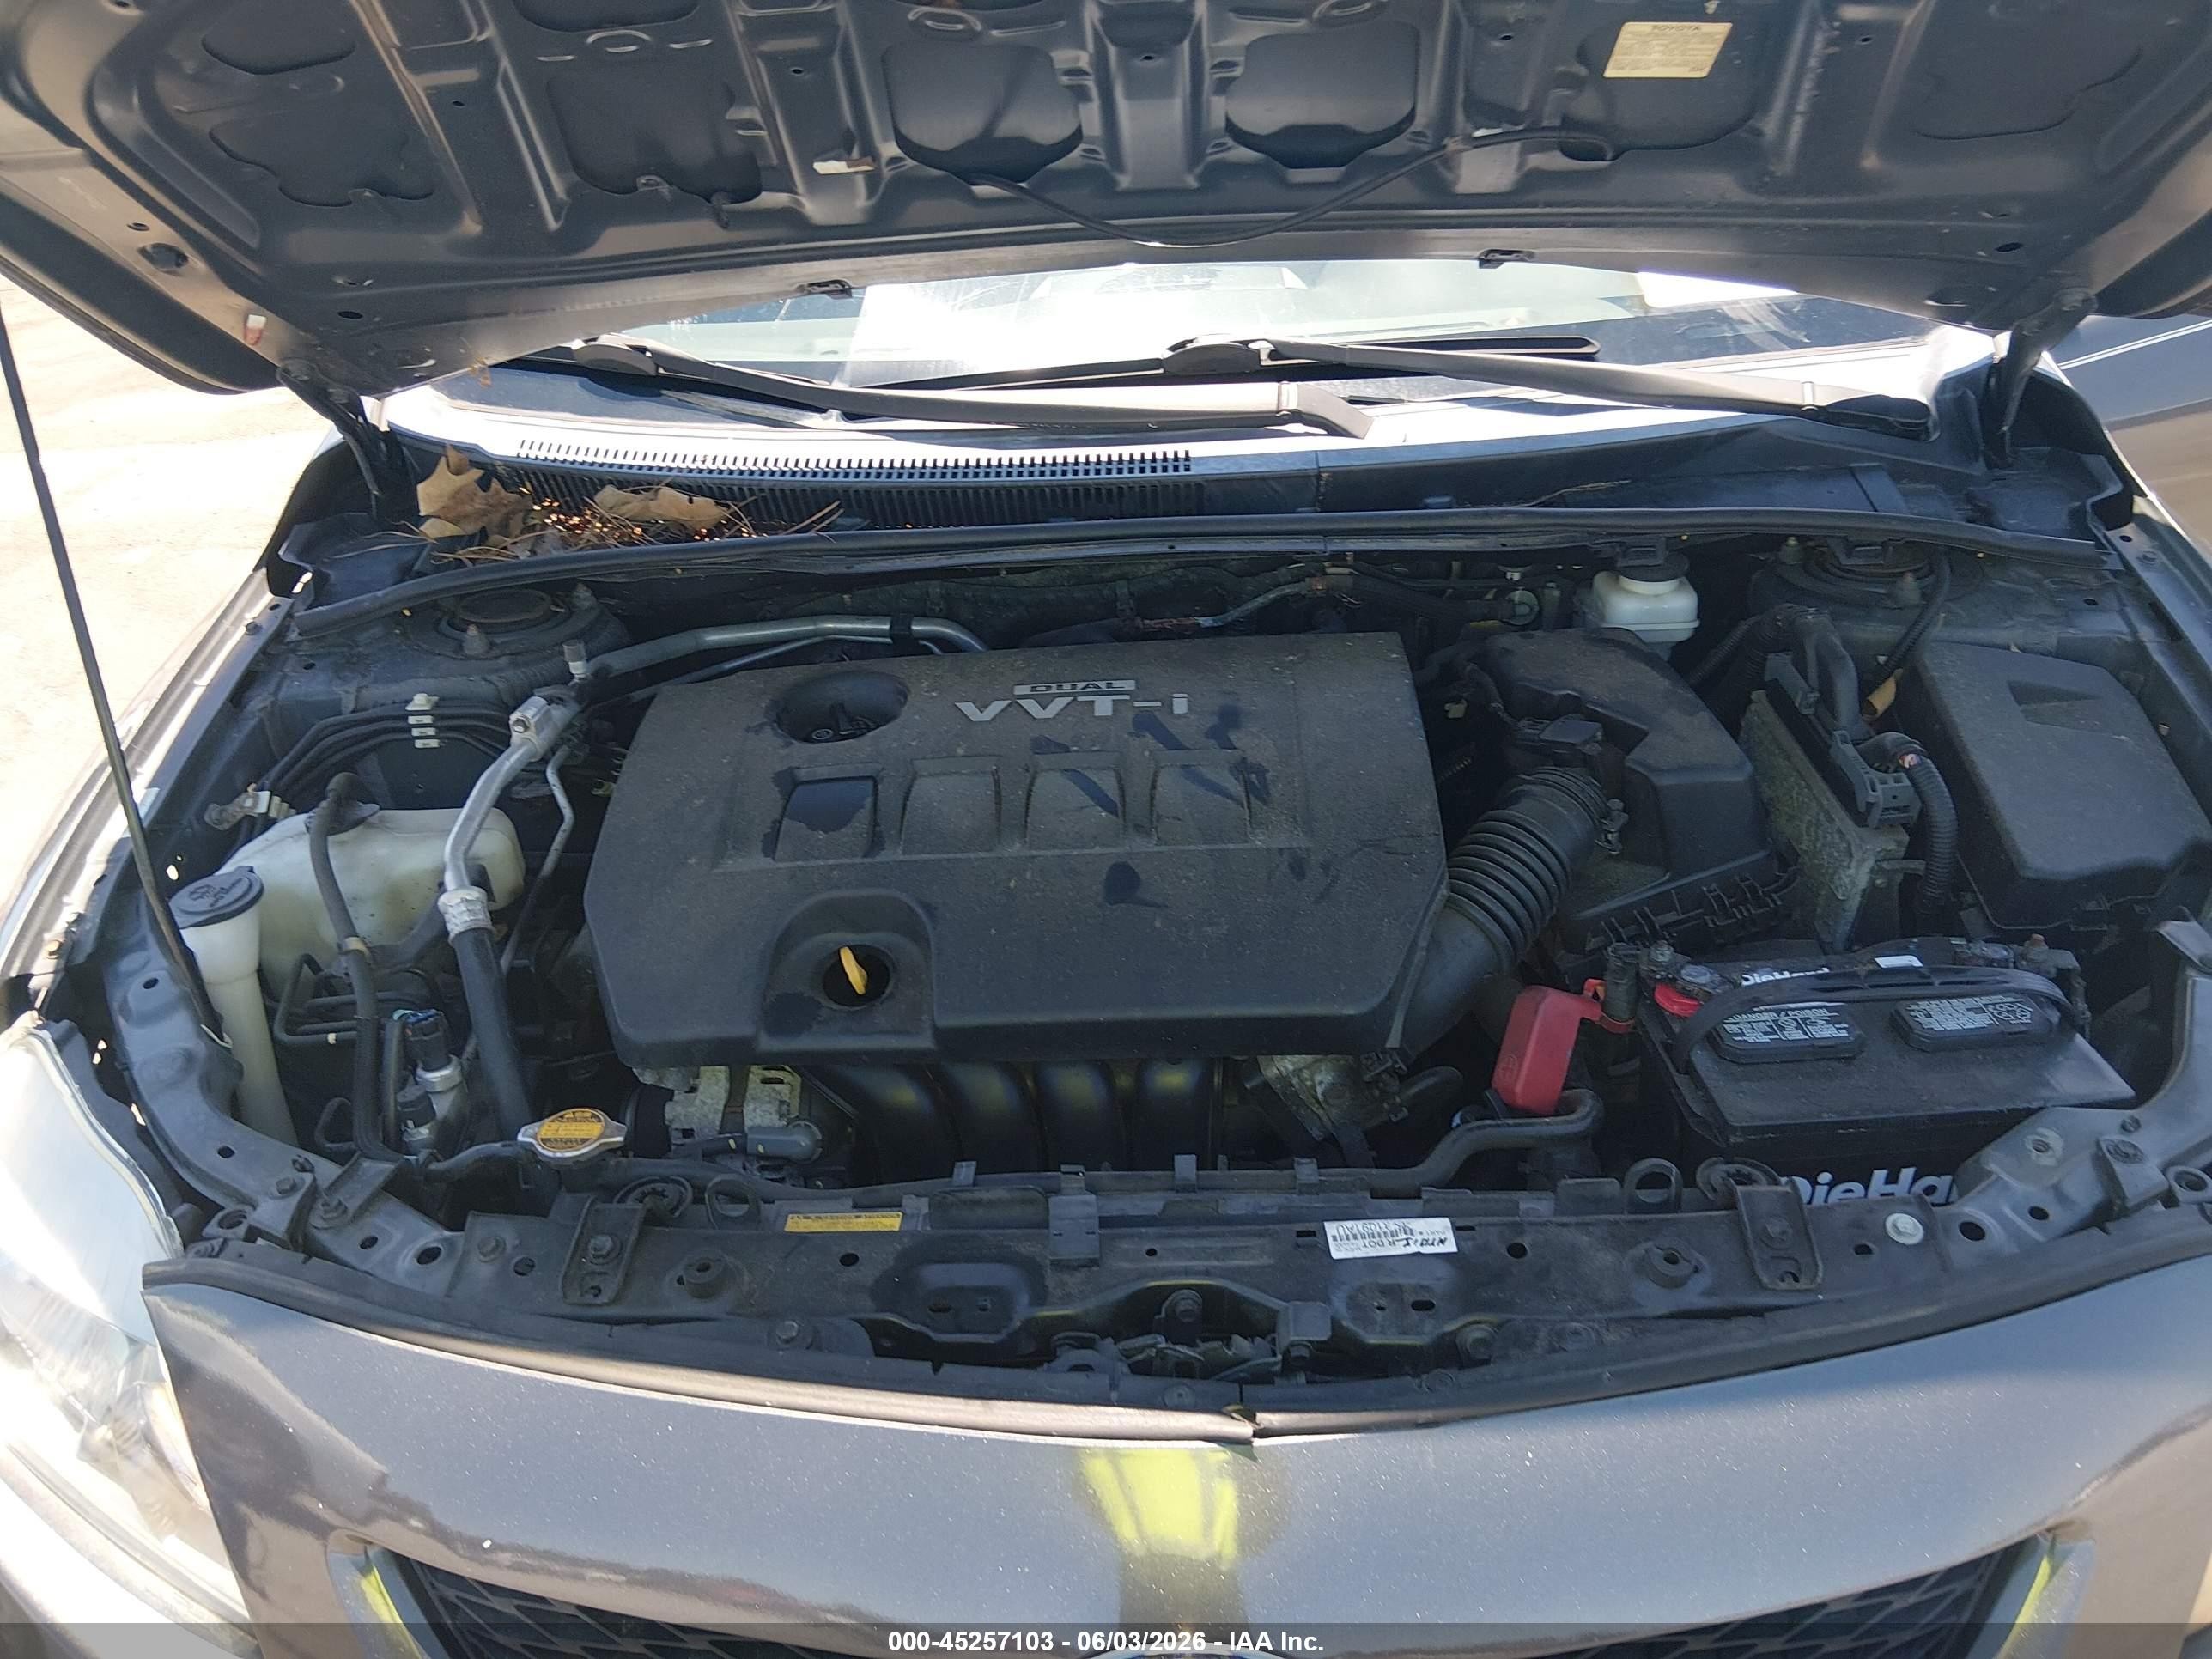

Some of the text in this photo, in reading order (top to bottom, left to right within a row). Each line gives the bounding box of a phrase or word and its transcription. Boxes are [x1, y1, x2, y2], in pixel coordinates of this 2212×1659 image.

[1030, 682, 1126, 692] DUAL
[954, 693, 1189, 722] VVT-i
[1787, 1009, 1828, 1018] POISON
